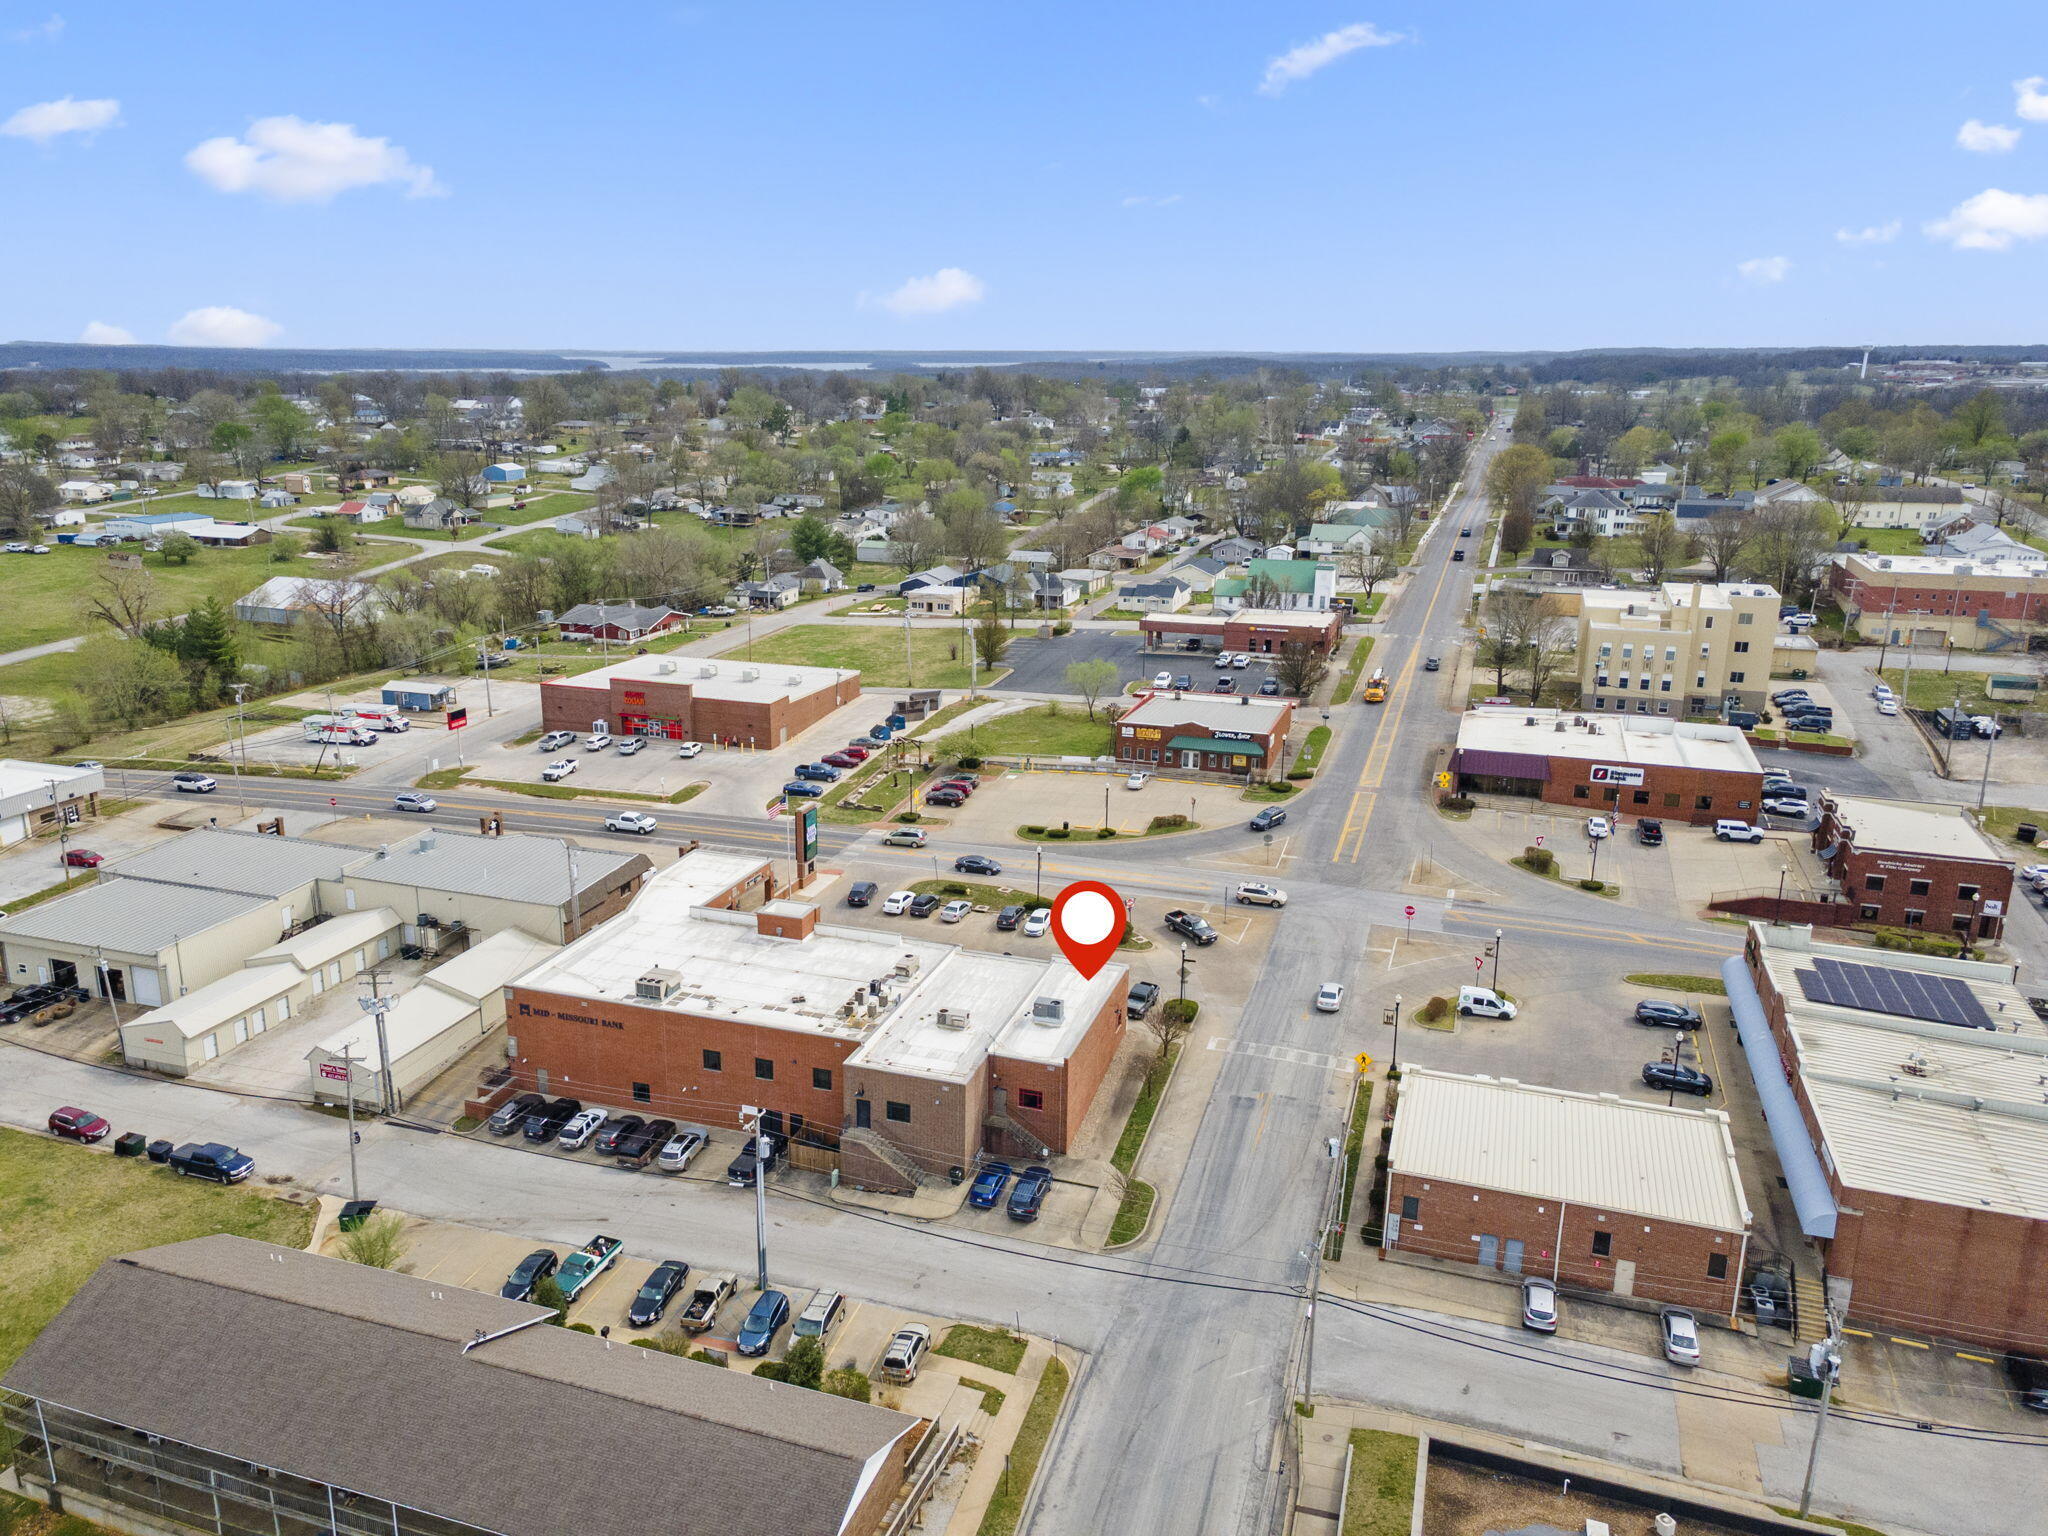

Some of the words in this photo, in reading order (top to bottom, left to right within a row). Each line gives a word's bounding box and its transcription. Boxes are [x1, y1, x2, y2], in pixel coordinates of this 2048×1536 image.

[533, 1008, 550, 1017] MID
[557, 1012, 598, 1026] MISSOURI
[601, 1019, 625, 1030] BANK
